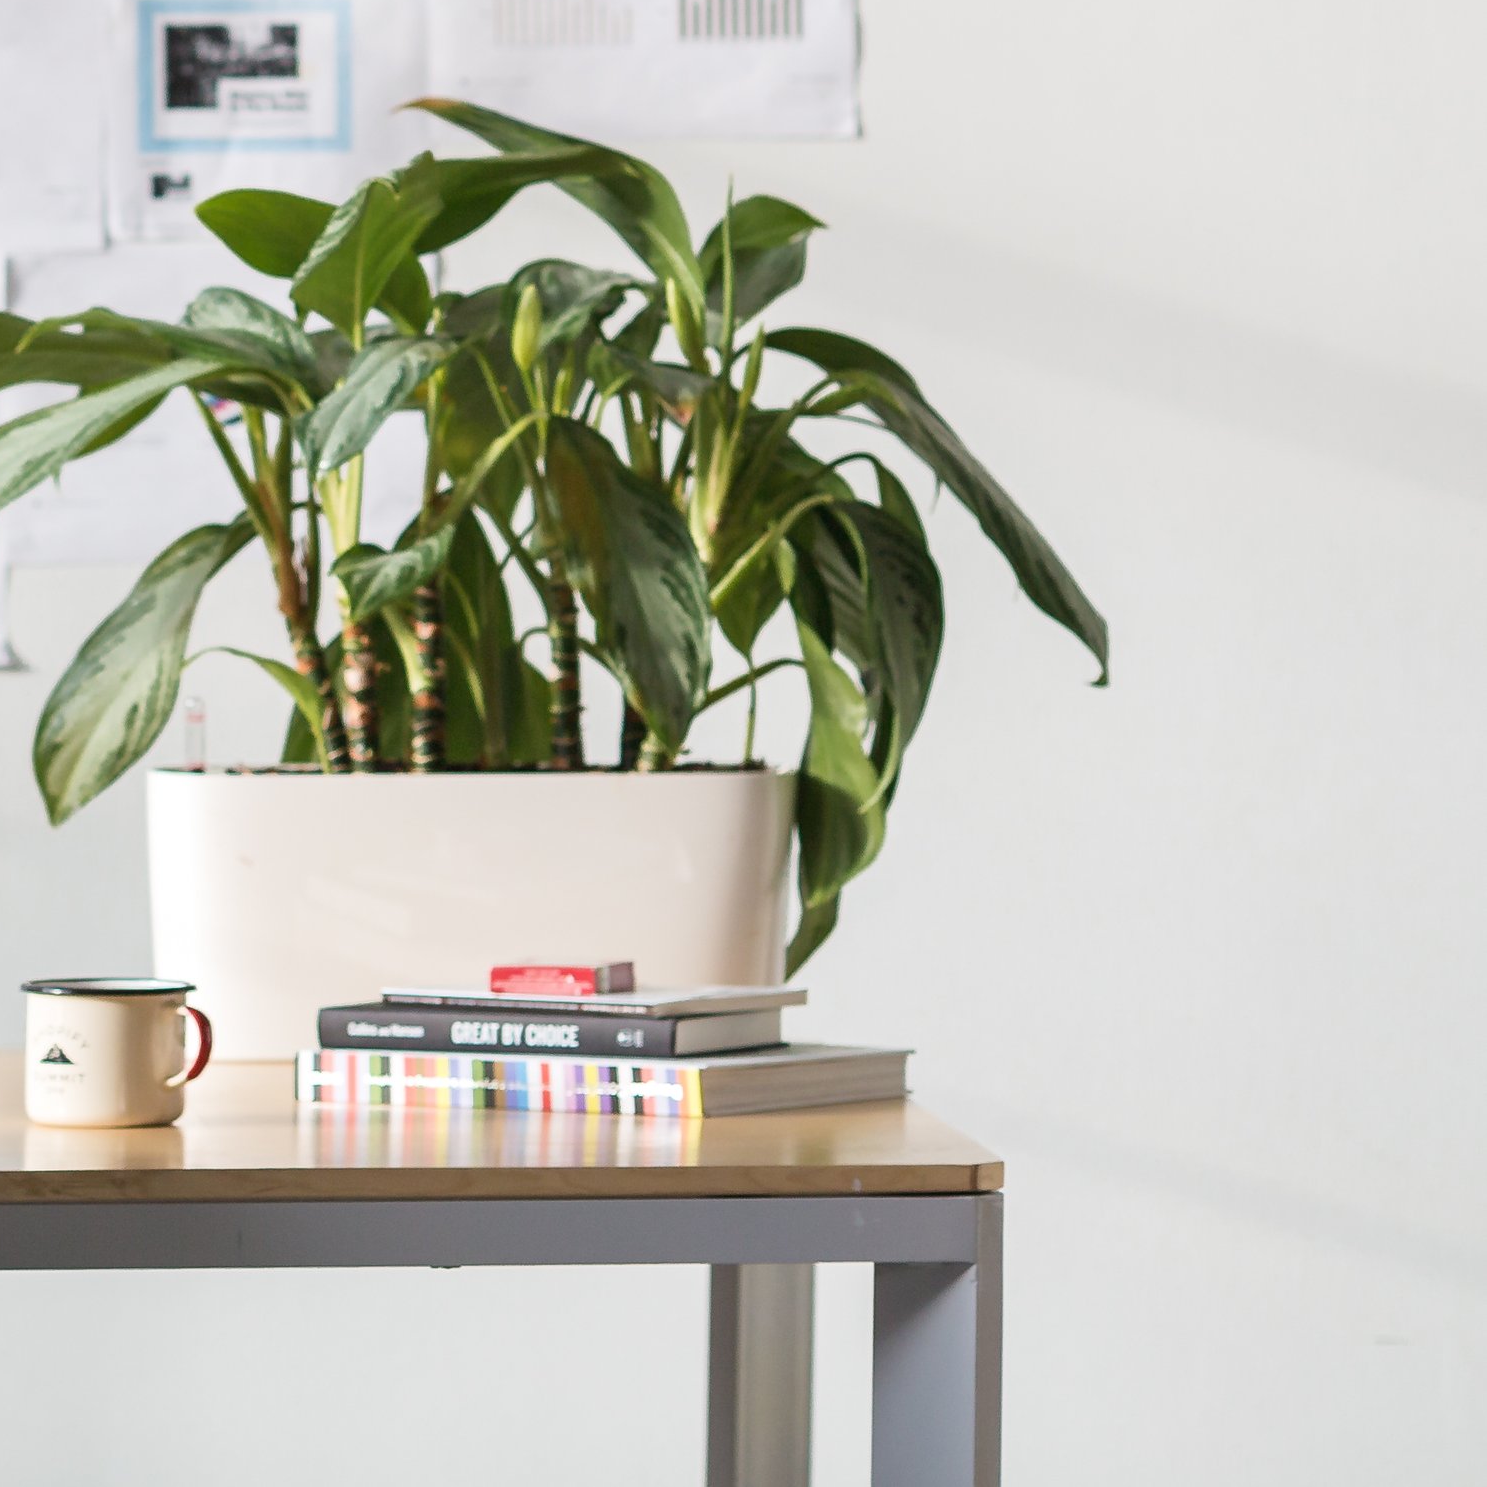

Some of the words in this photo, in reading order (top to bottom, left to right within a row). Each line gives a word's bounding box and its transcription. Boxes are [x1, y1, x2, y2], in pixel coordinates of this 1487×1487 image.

[451, 1021, 499, 1044] GREAT
[502, 1023, 523, 1045] BY
[525, 1024, 579, 1047] CHOICE
